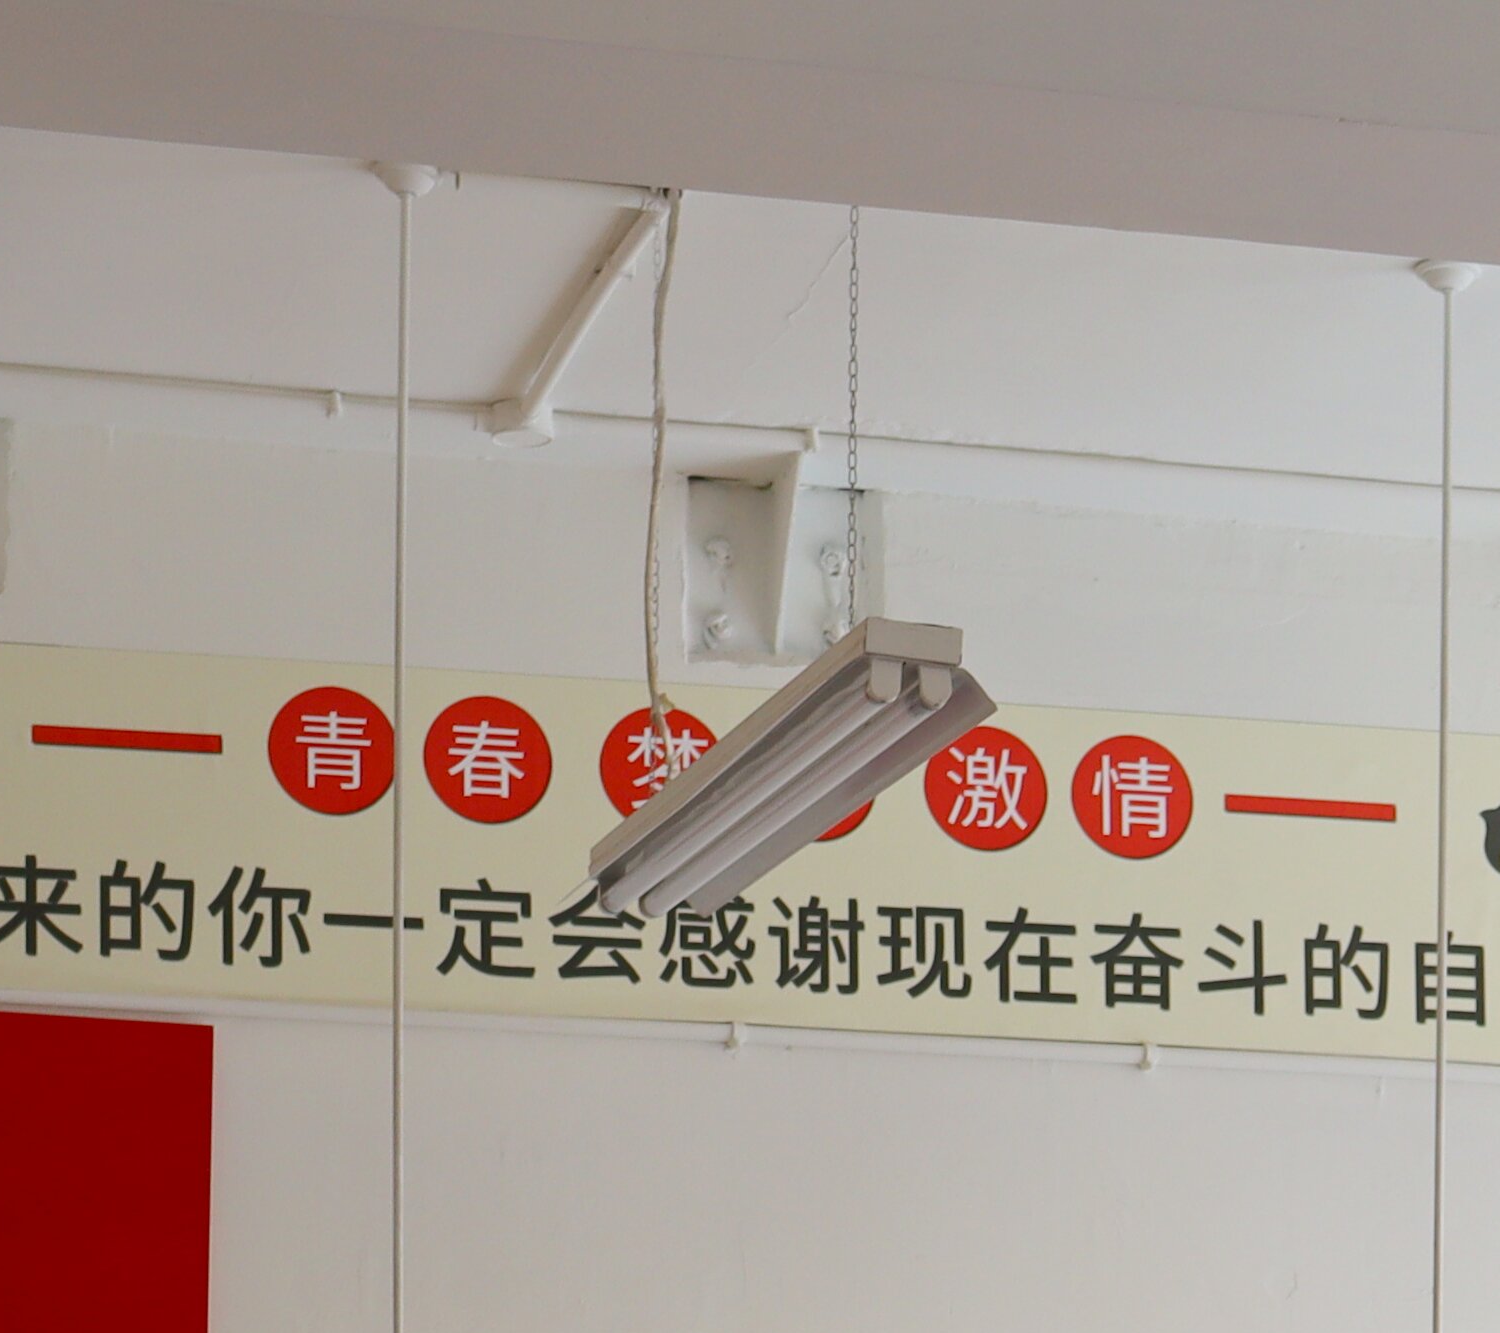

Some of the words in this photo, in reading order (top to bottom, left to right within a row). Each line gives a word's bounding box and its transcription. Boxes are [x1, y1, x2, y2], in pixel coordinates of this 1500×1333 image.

[294, 709, 1175, 842] 青春梦激情
